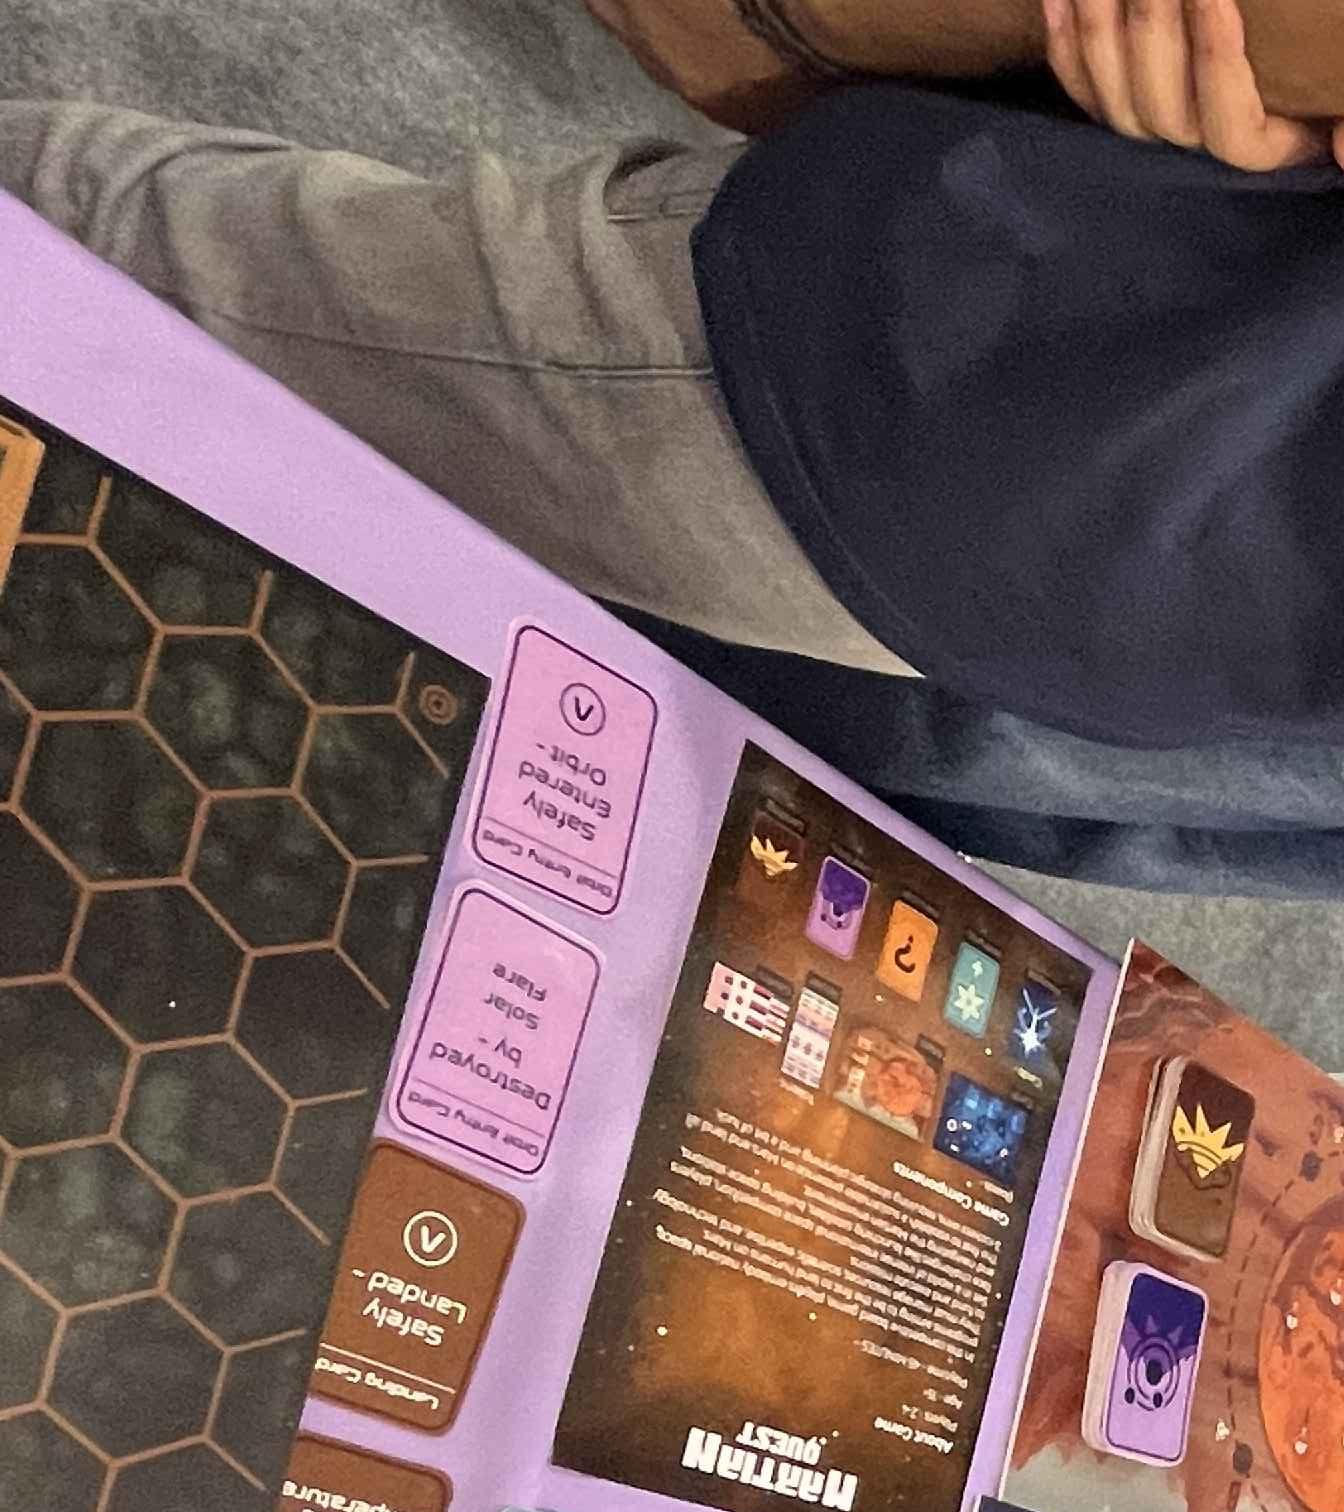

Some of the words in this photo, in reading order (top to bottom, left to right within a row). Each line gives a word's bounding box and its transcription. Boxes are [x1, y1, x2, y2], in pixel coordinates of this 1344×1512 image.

[549, 743, 607, 787] Orbit
[518, 760, 612, 819] Entered
[522, 790, 596, 842] Safely
[482, 829, 523, 857] Card
[492, 962, 547, 1002] Flare
[484, 992, 540, 1031] Solar
[493, 1038, 522, 1069] by
[429, 1041, 552, 1111] Destroyed
[408, 1092, 450, 1117] Card
[892, 1161, 972, 1210] Components
[973, 1200, 1010, 1227] Game
[367, 1271, 467, 1324] Landed
[362, 1297, 445, 1346] Safely
[314, 1357, 362, 1384] Card
[364, 1371, 440, 1410] Landing
[874, 1416, 913, 1442] Game
[914, 1430, 953, 1454] About
